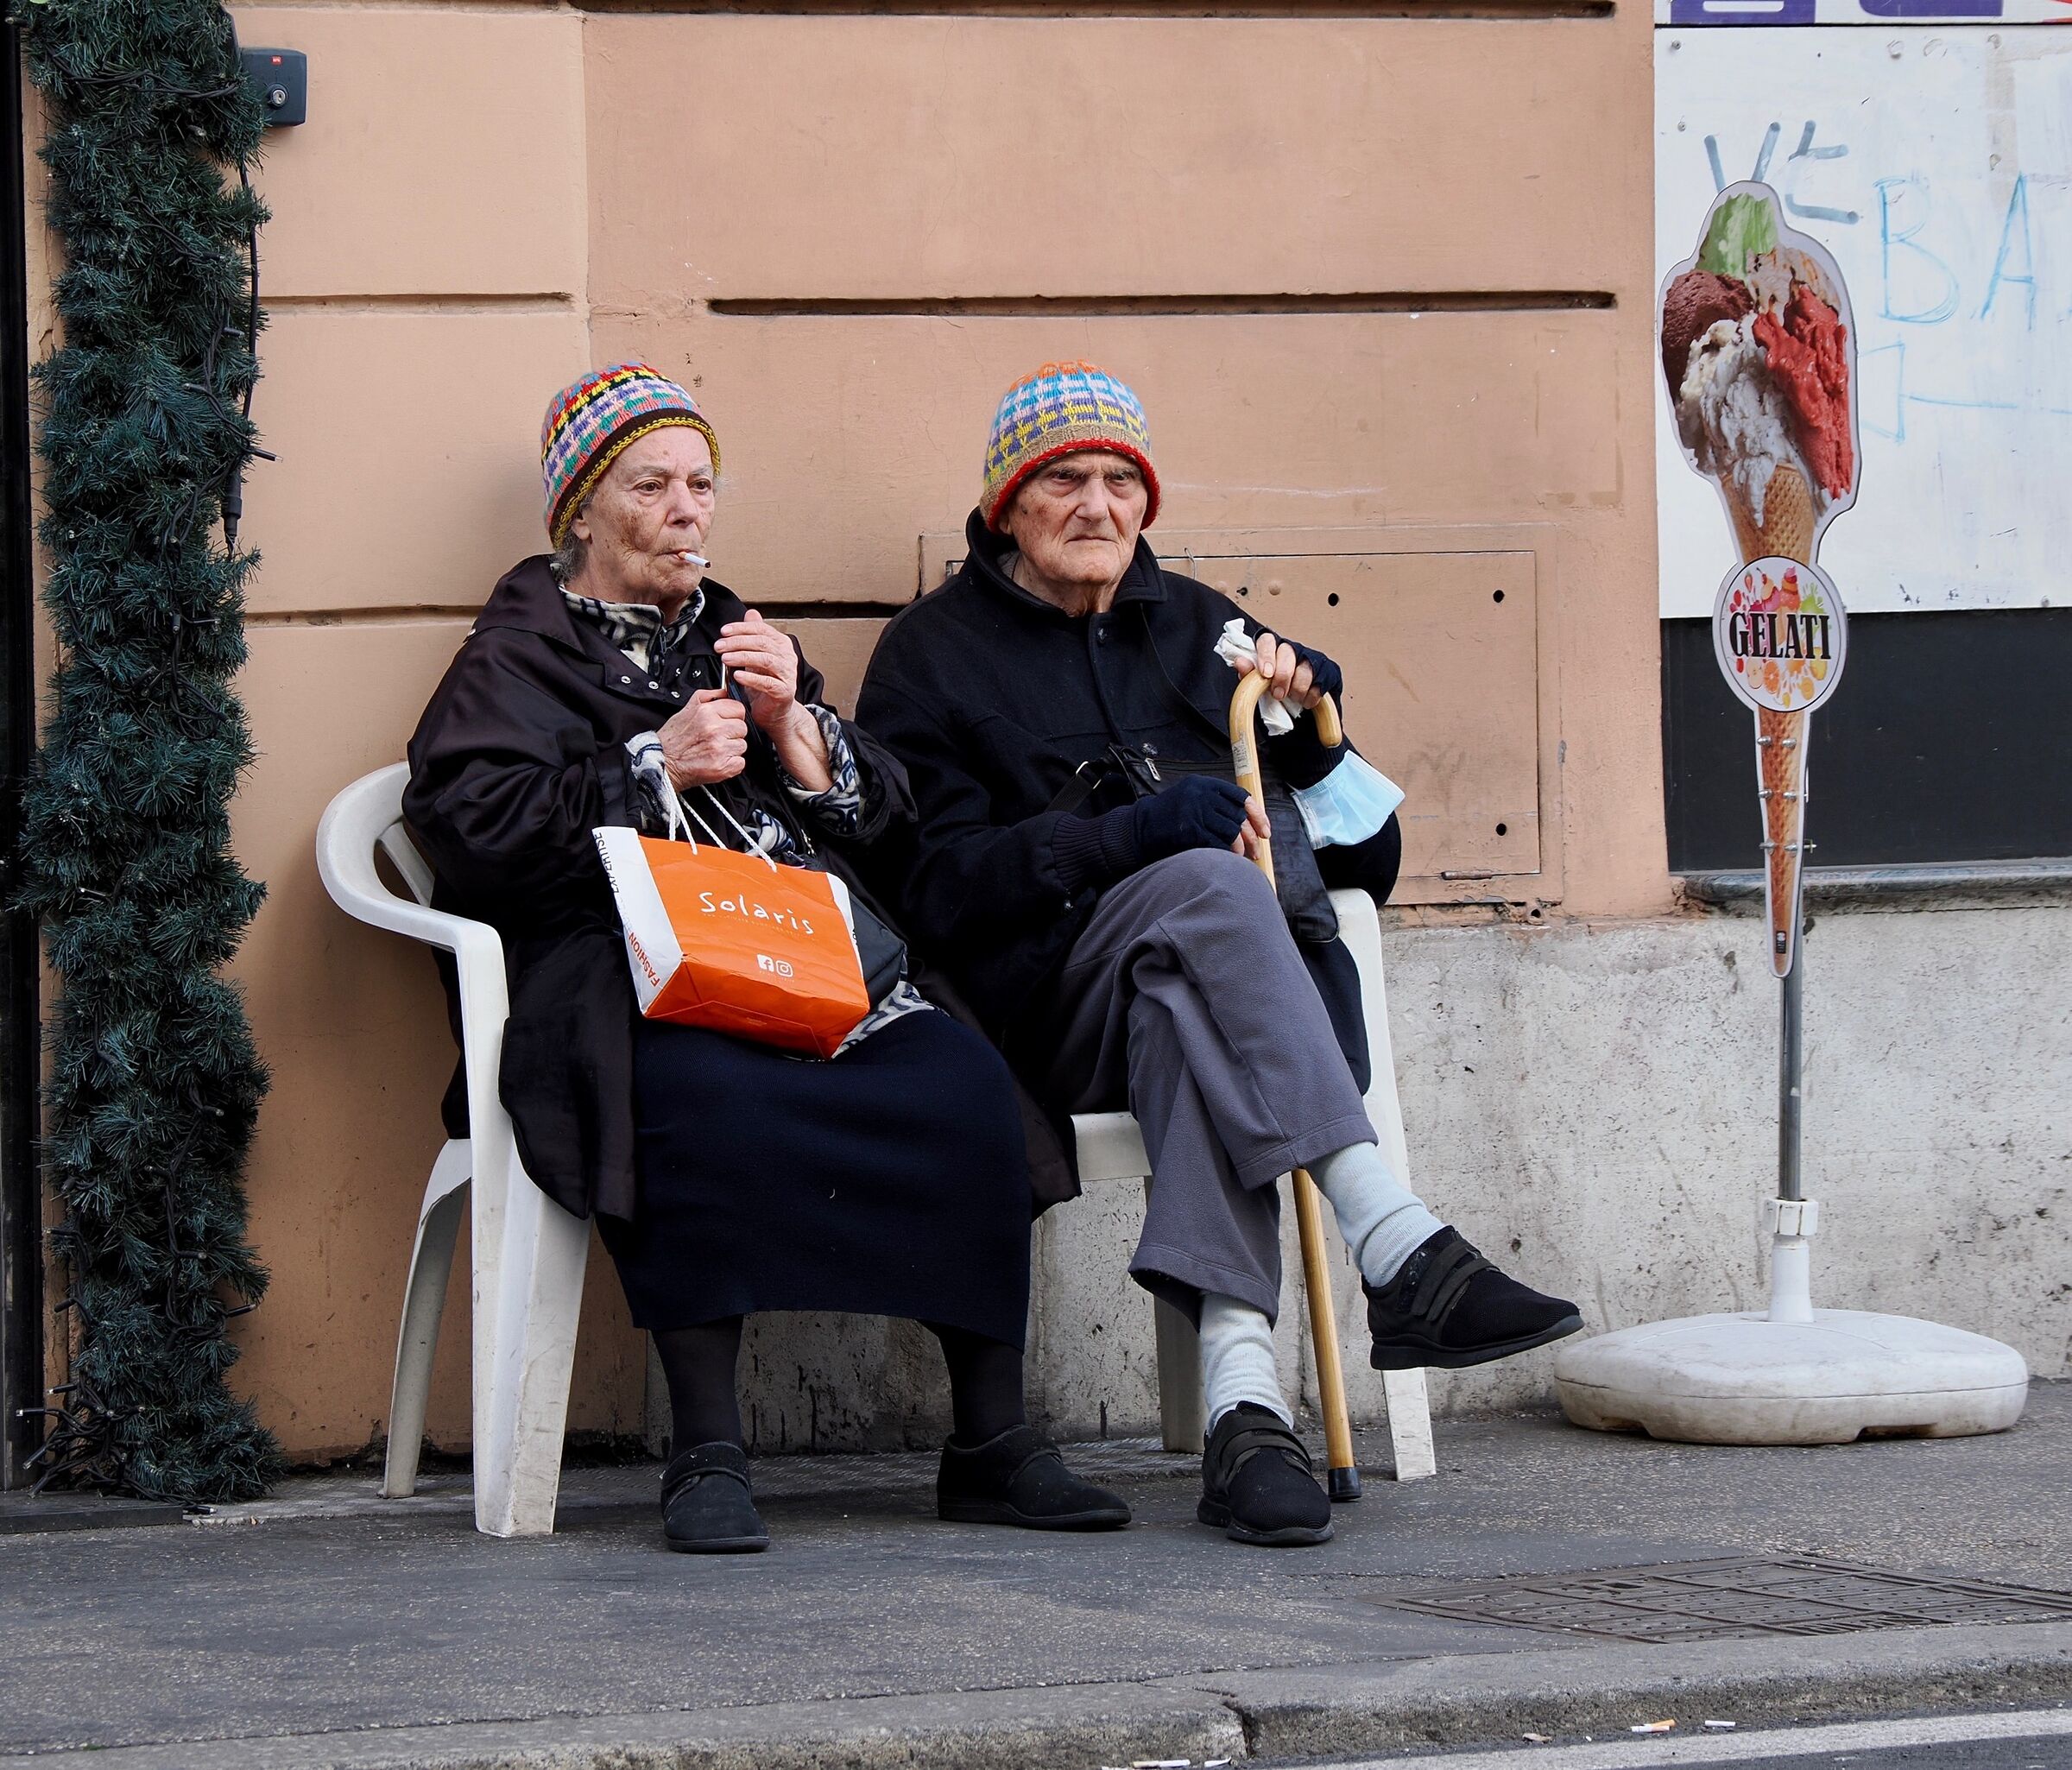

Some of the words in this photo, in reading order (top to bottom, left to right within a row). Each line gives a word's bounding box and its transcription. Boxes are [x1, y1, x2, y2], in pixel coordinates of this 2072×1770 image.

[1729, 611, 1832, 660] GELATI
[698, 891, 814, 934] Solaris
[629, 932, 660, 987] FASHION
